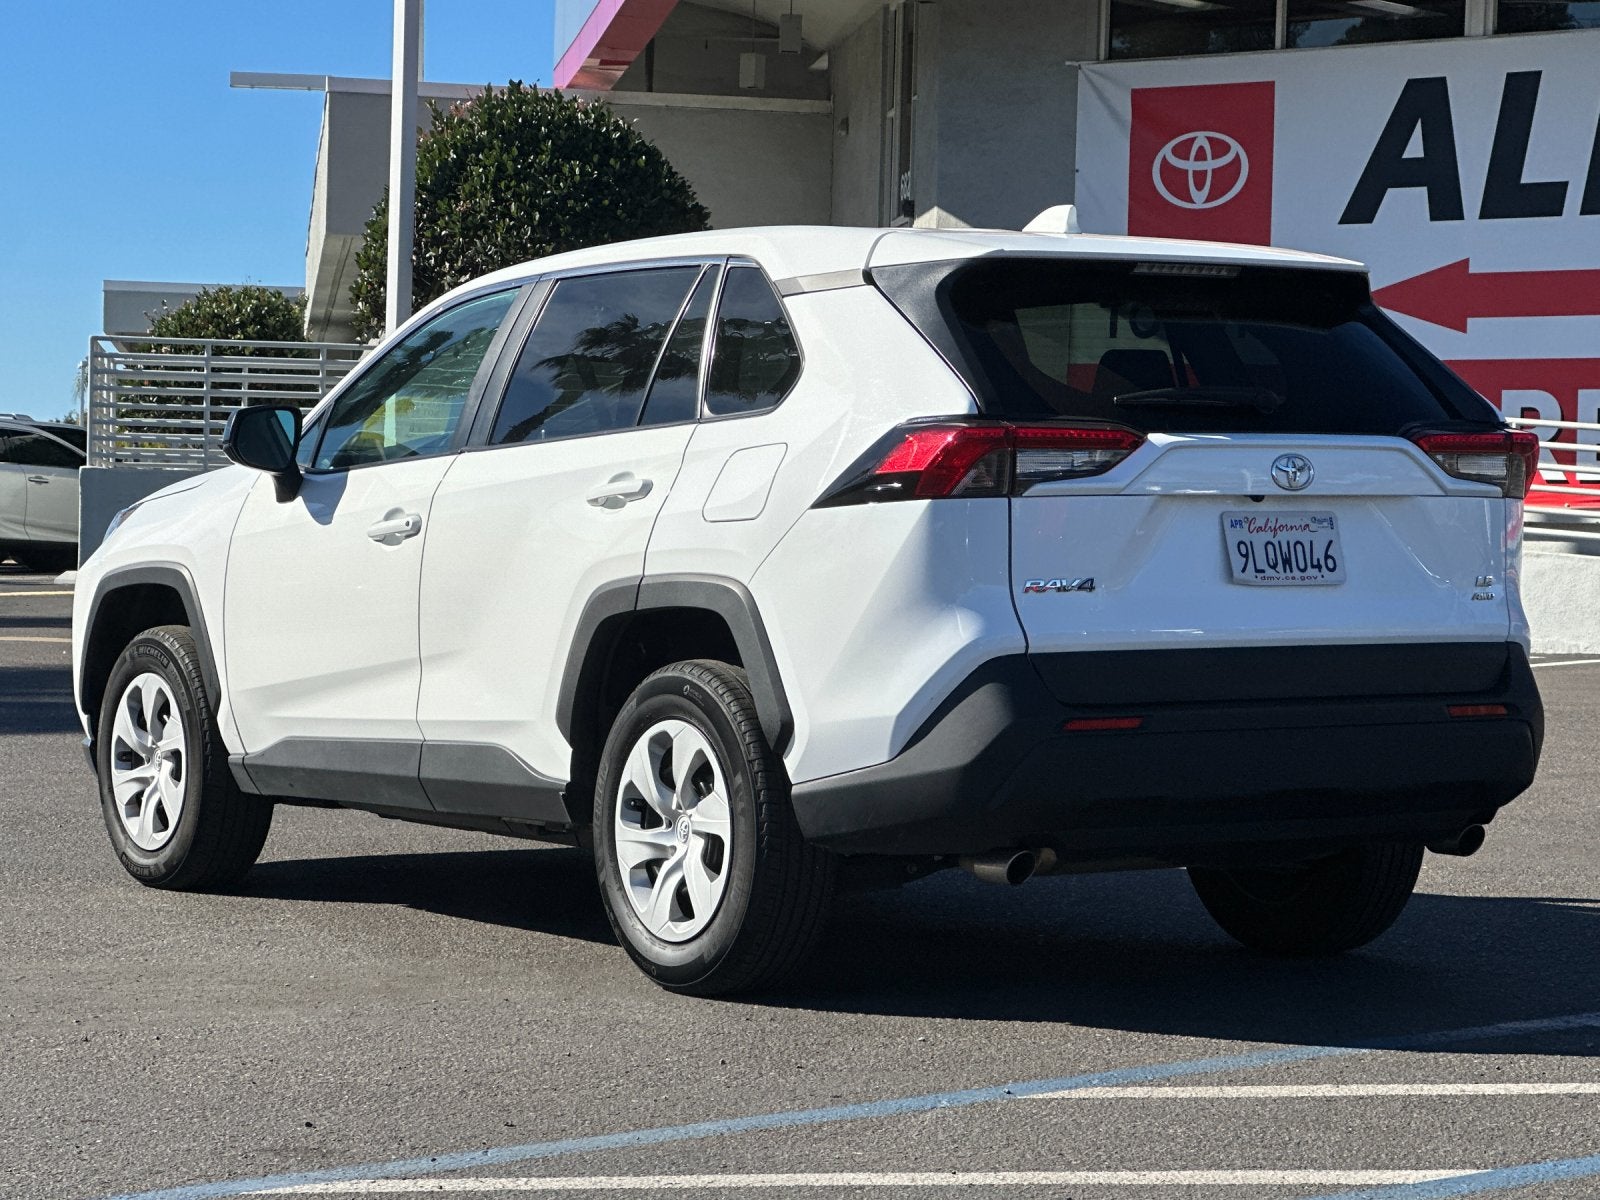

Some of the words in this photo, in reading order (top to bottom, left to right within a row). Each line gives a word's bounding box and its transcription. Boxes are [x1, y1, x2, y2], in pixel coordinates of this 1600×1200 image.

[1338, 69, 1600, 225] AL
[1247, 517, 1318, 538] California
[1236, 539, 1337, 574] 9LQW046
[1023, 577, 1096, 593] RAV4
[138, 646, 169, 667] MICHELIN
